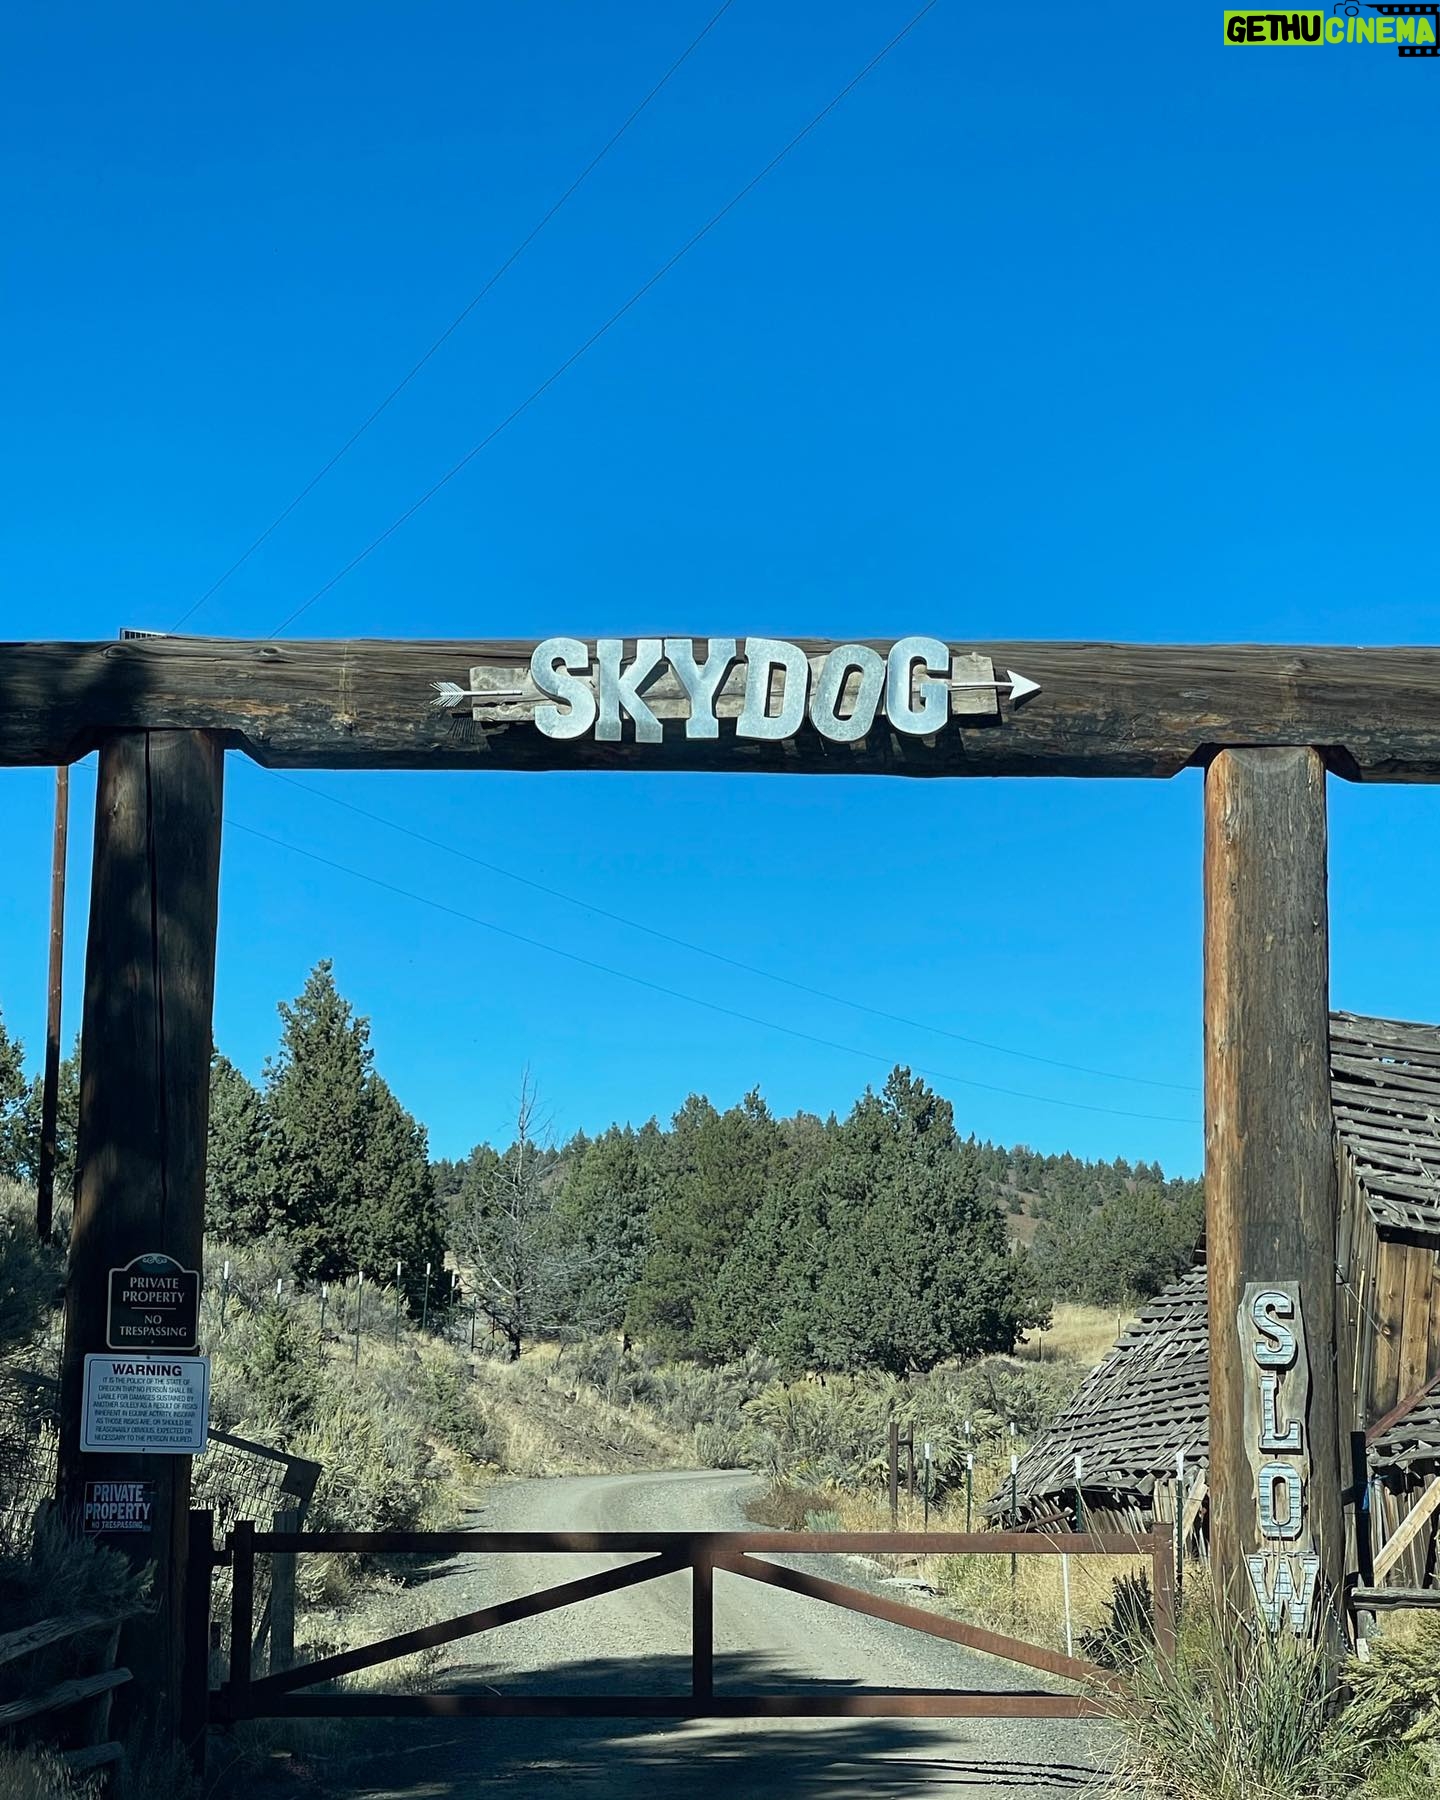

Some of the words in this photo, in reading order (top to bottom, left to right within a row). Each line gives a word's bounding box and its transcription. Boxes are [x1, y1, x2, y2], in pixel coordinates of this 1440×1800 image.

[530, 636, 950, 743] SKYDOG
[130, 1277, 179, 1289] PRIVATE
[122, 1291, 185, 1303] PROPERTY
[144, 1314, 162, 1325] NO
[120, 1326, 187, 1337] TRESPASSING
[112, 1363, 182, 1376] WARNING
[1245, 1291, 1320, 1634] SLOW
[94, 1484, 144, 1502] PRIVATE
[85, 1502, 151, 1520] PROPERTY
